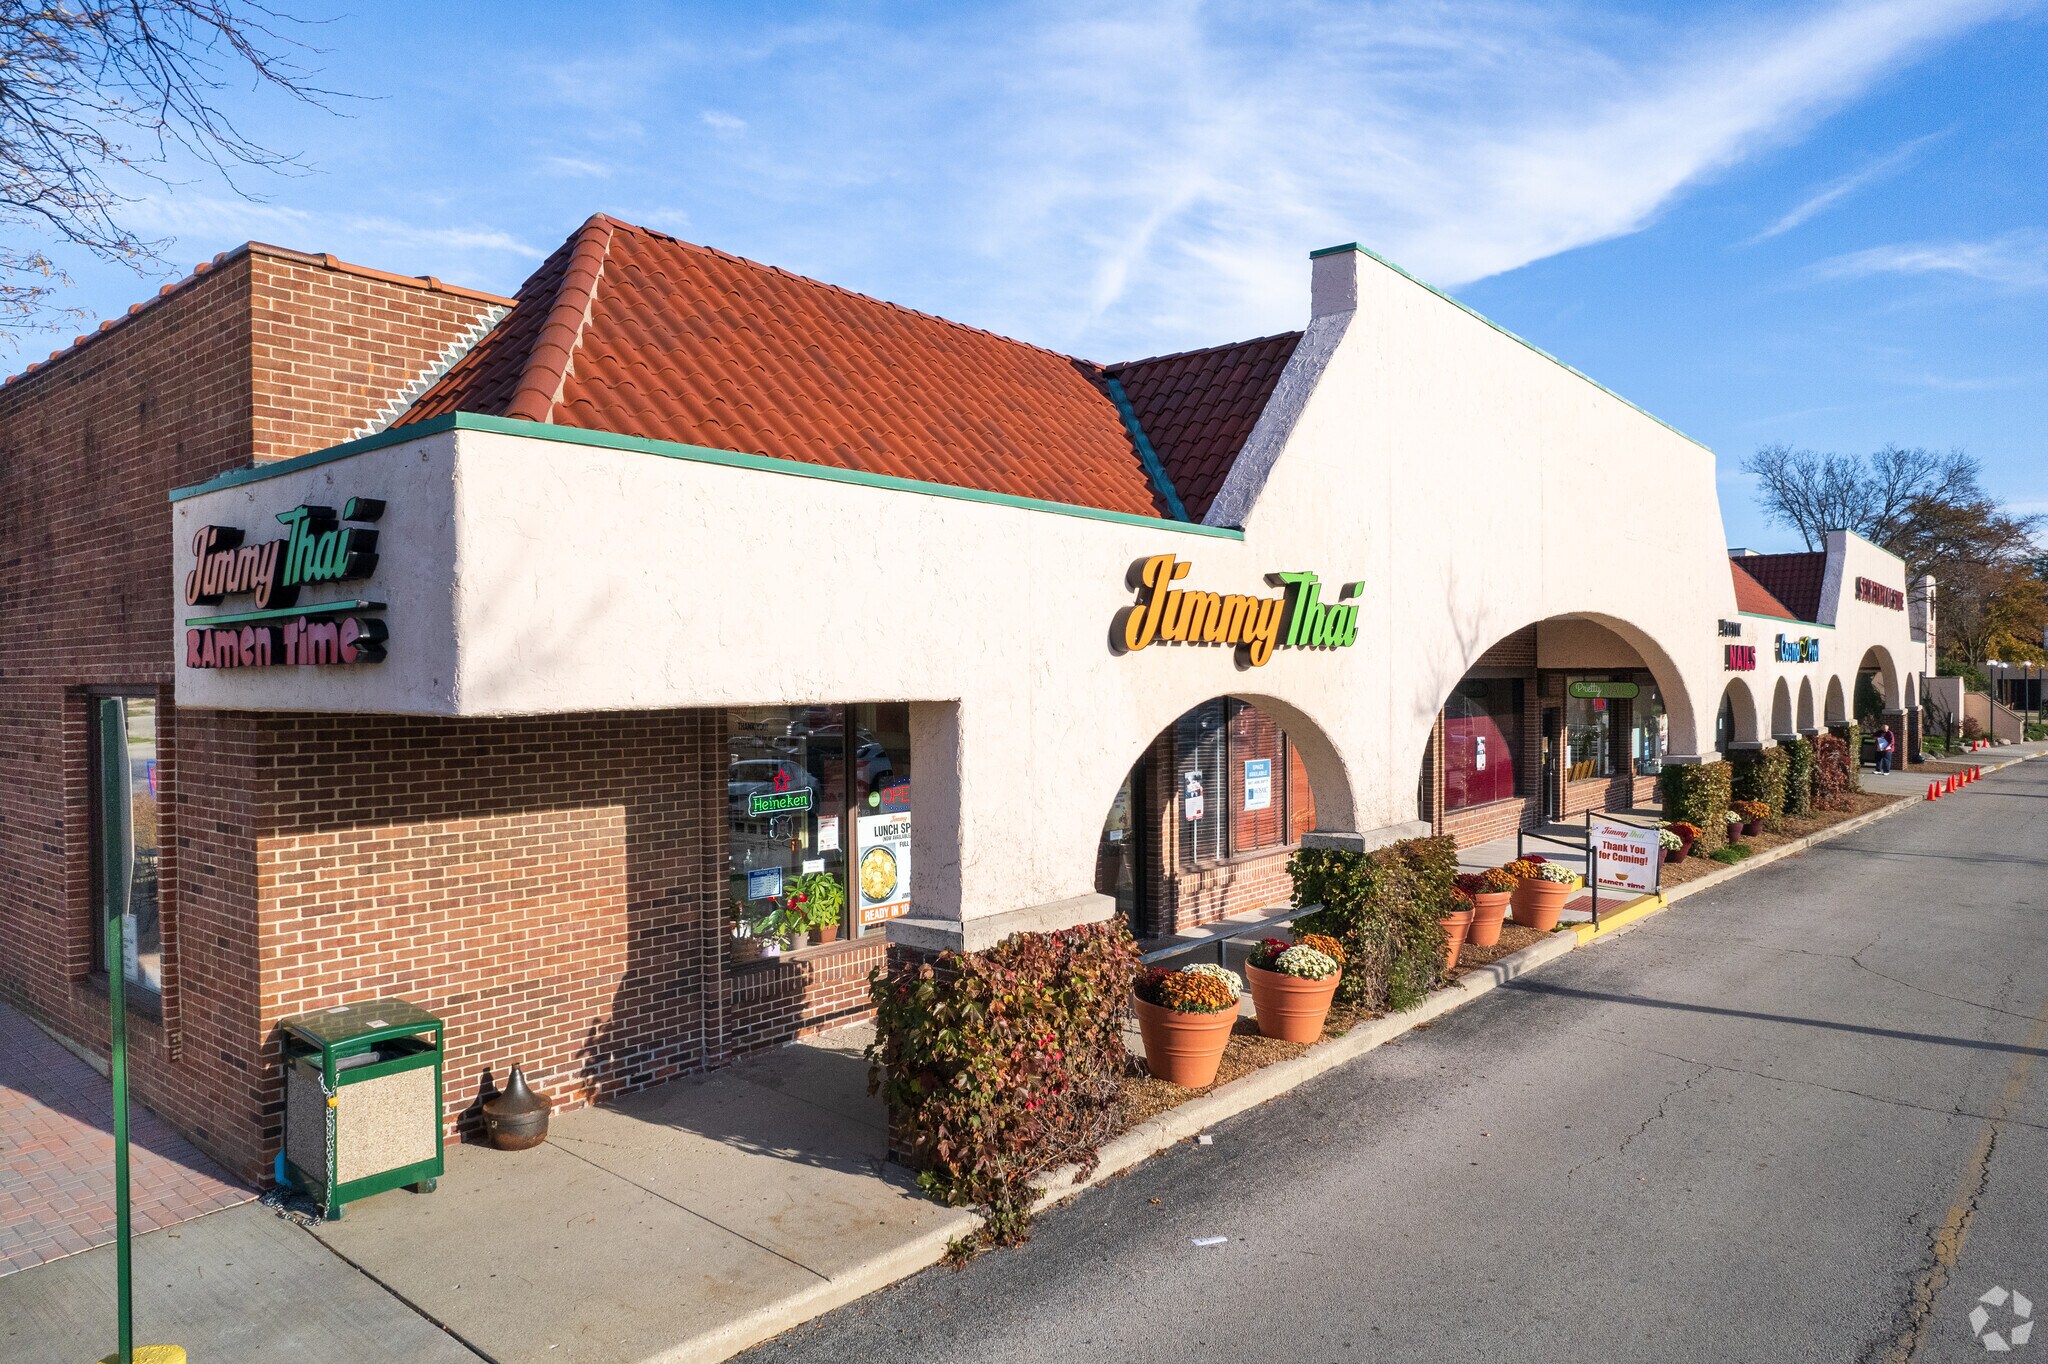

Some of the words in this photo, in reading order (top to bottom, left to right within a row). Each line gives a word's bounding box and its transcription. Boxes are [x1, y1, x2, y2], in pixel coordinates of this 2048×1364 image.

[186, 525, 282, 609] Jimmy
[276, 496, 360, 588] Thai
[1125, 553, 1286, 667] Jimmy
[1279, 571, 1366, 647] Thai
[1729, 644, 1756, 671] NAILS
[1575, 682, 1602, 698] Pretty
[752, 793, 808, 812] Heineken
[882, 785, 910, 804] OPE
[874, 824, 899, 837] LUNCH
[900, 822, 911, 834] SP
[1601, 826, 1628, 839] Jimmy
[1629, 830, 1646, 839] Thai
[1602, 841, 1628, 853] Thank
[1630, 845, 1646, 855] You
[1598, 850, 1611, 860] for
[1612, 852, 1648, 866] Coming!
[864, 906, 890, 921] READY
[891, 905, 899, 915] IN
